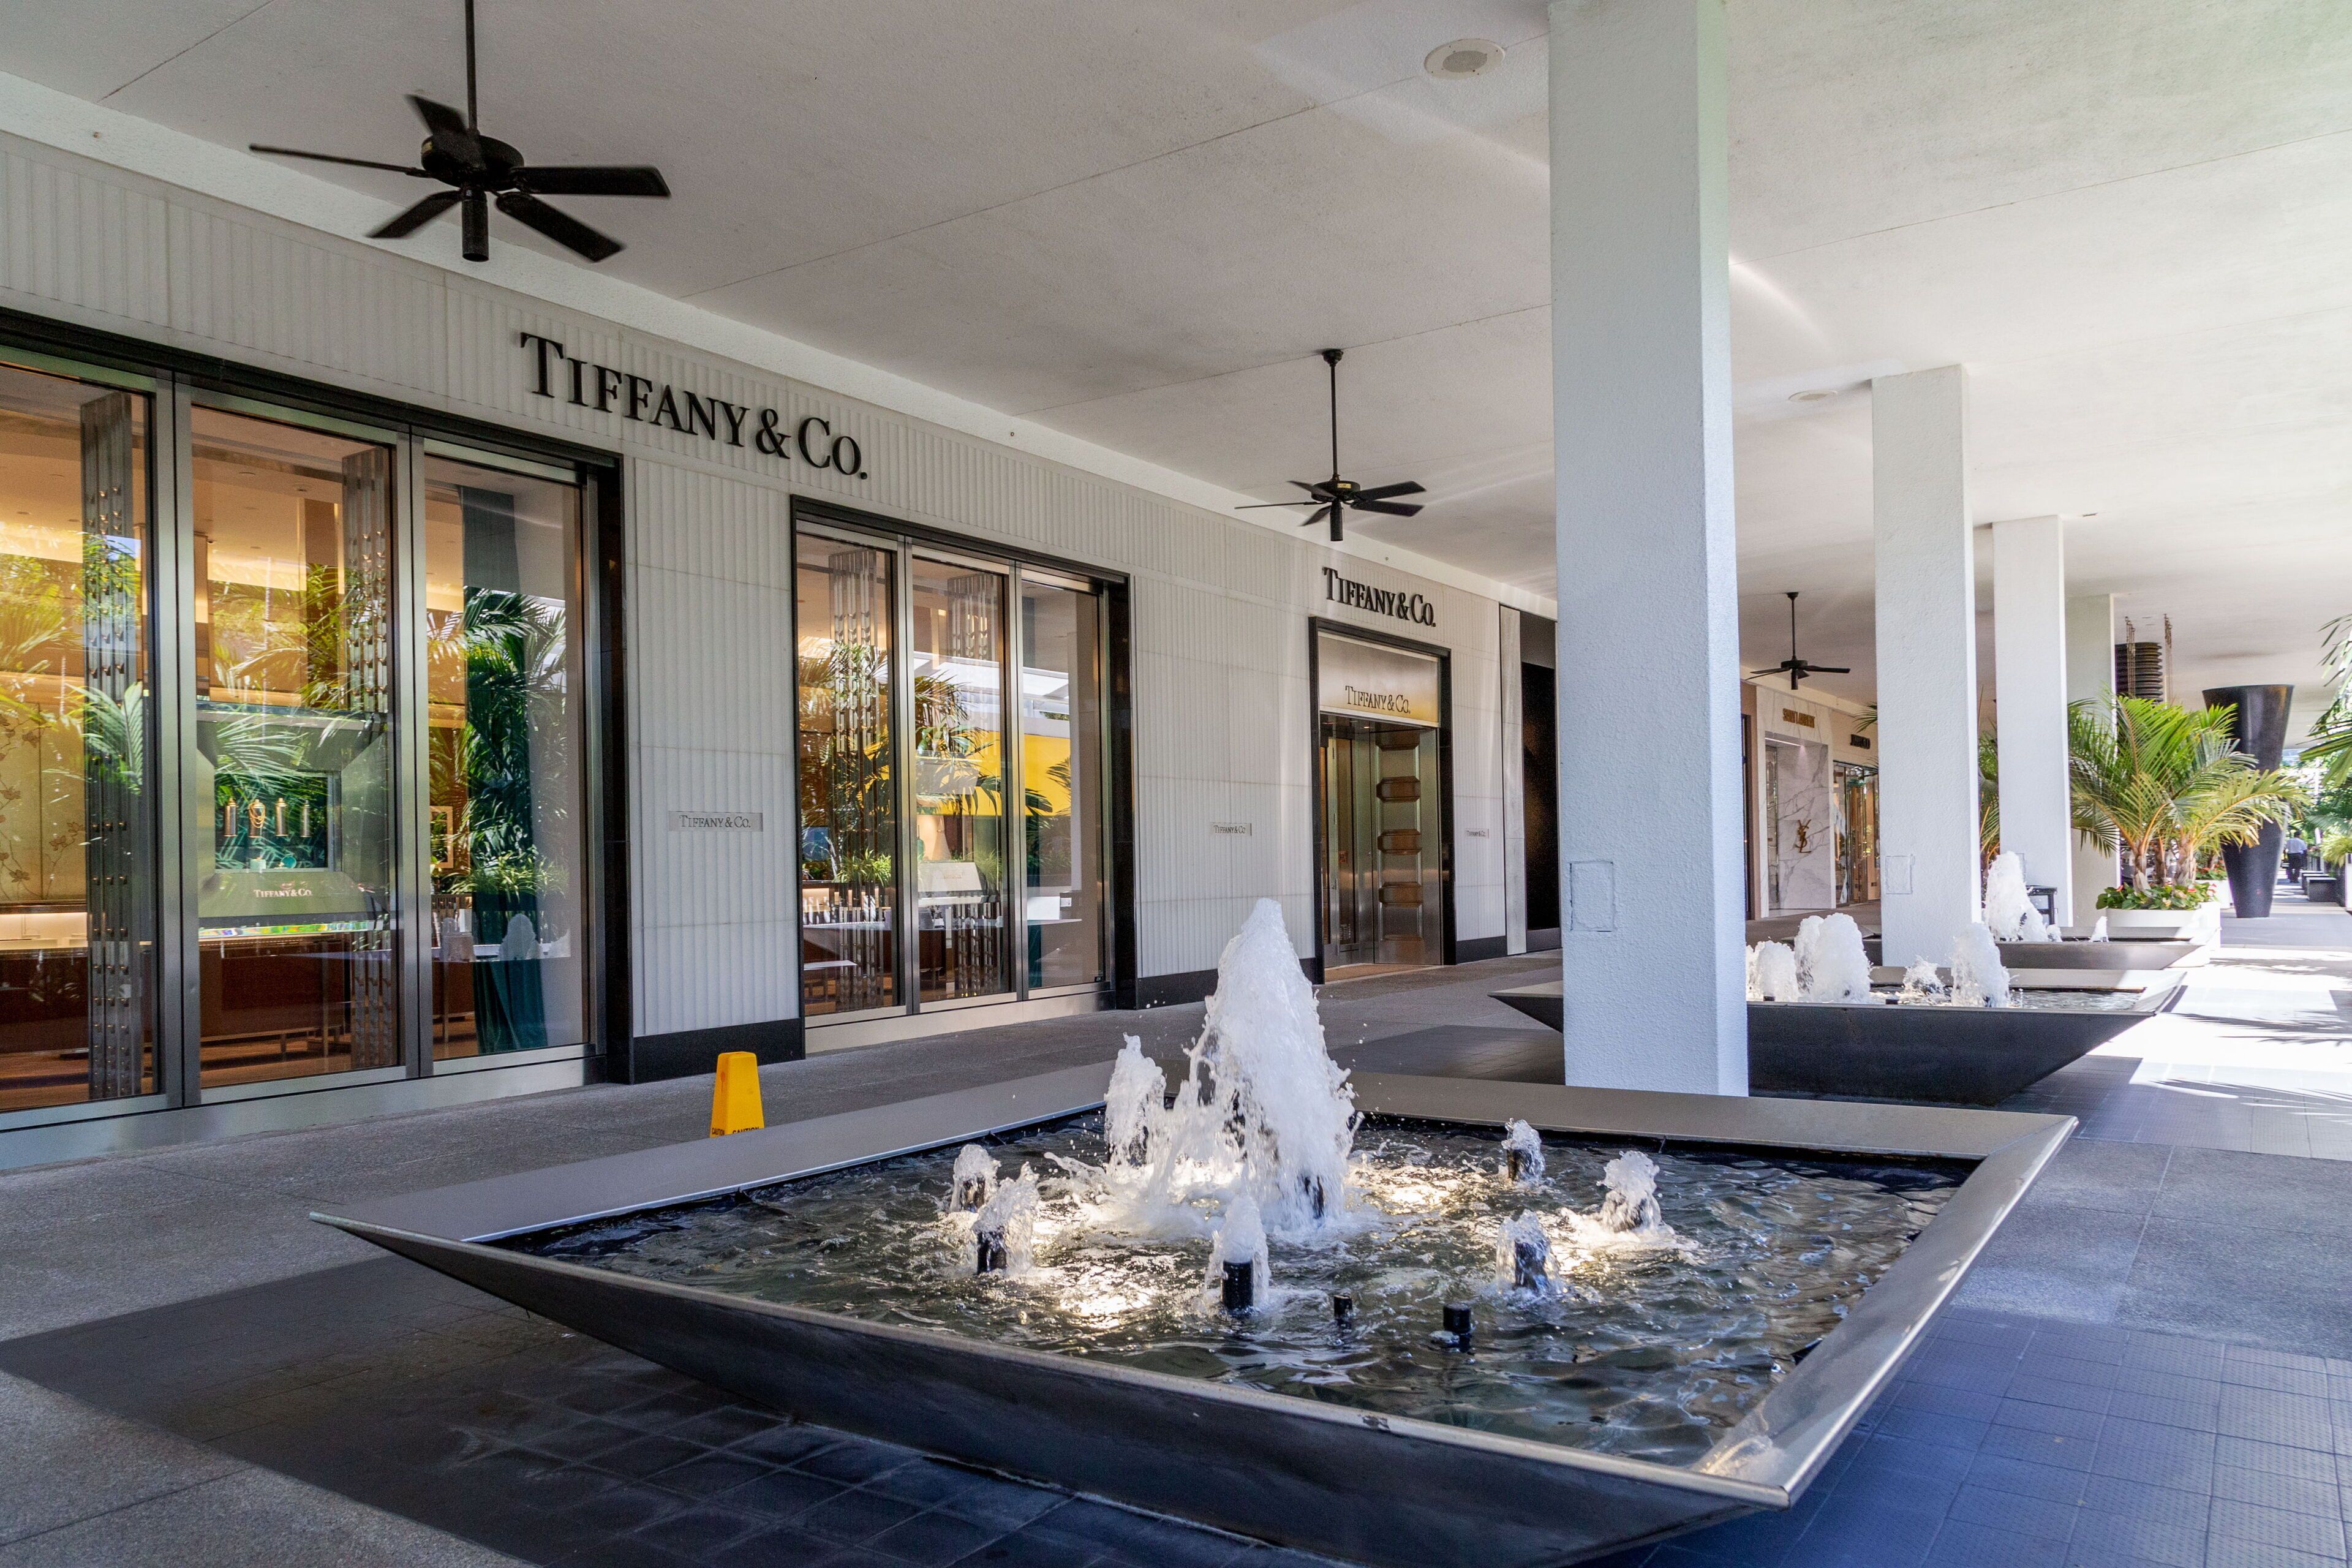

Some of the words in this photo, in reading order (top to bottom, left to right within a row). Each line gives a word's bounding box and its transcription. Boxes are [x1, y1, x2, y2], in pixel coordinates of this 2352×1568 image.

[521, 332, 750, 447] TIFFANY
[1322, 567, 1397, 616] TIFFANY
[1345, 685, 1387, 710] TIFFANY
[679, 815, 723, 827] TIFFANY
[1213, 824, 1235, 833] TIFFANY
